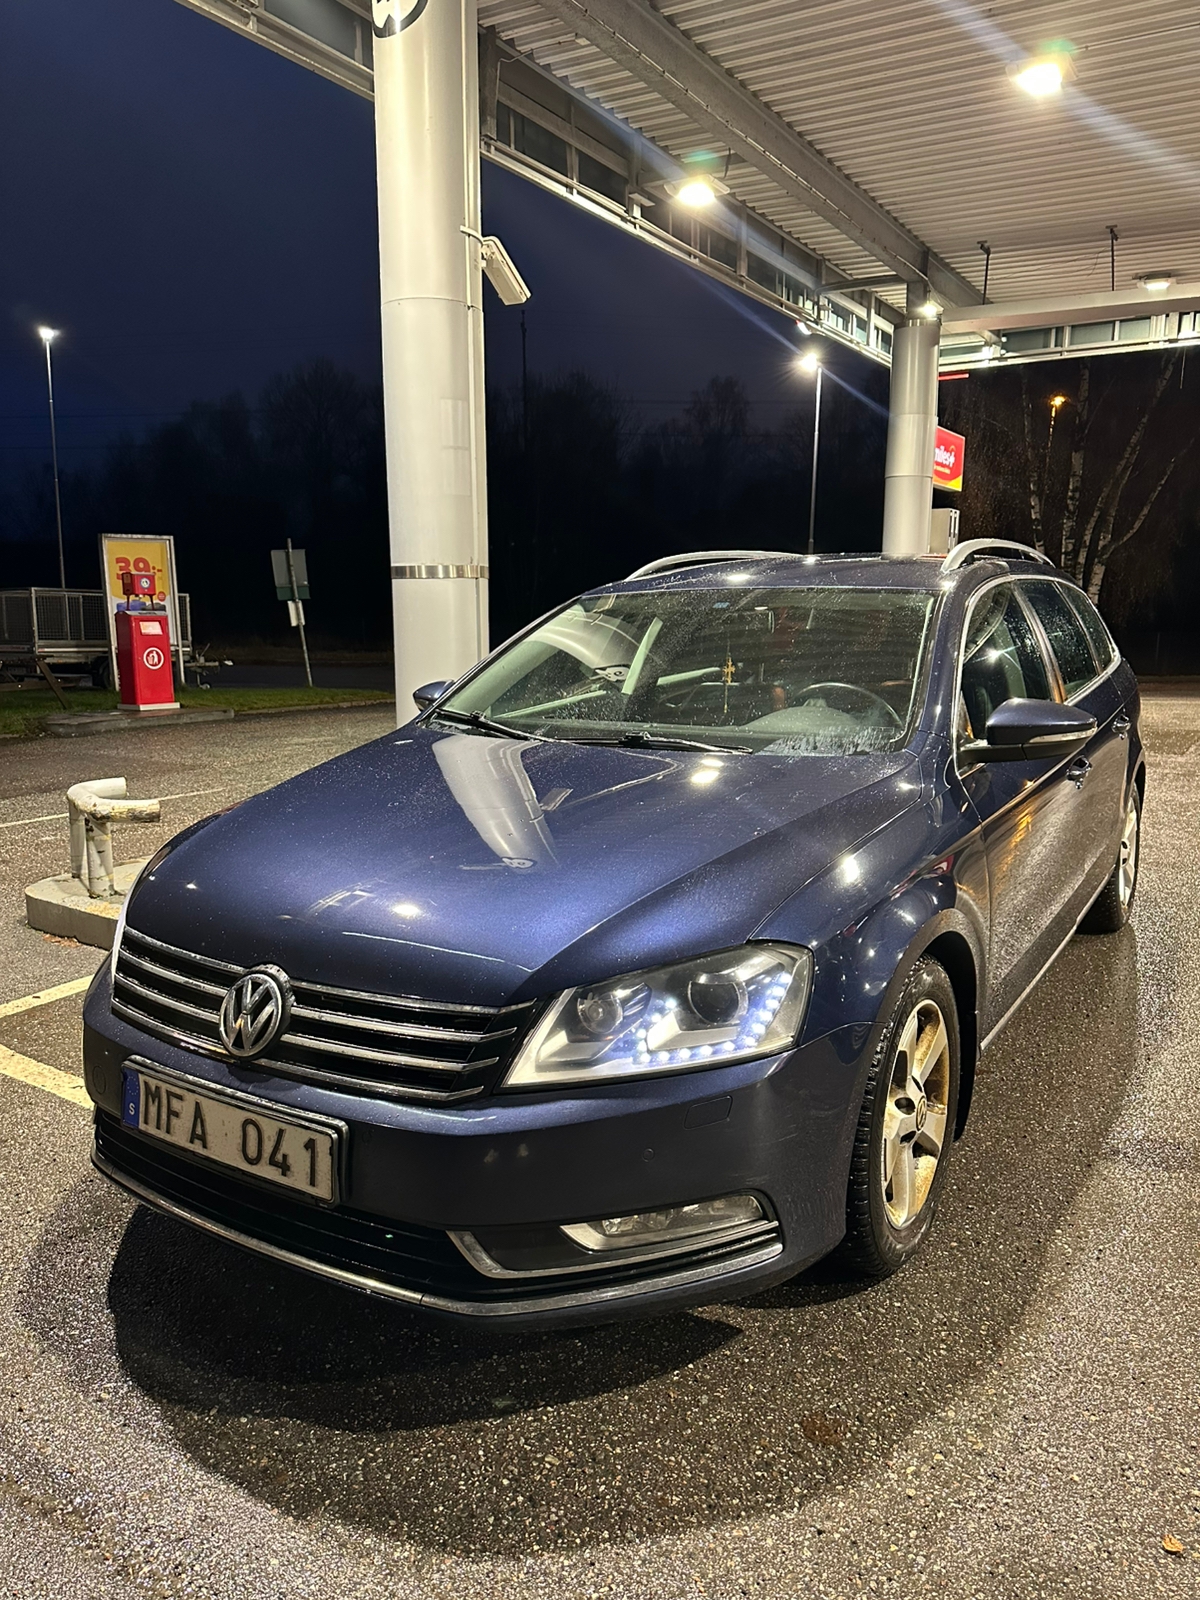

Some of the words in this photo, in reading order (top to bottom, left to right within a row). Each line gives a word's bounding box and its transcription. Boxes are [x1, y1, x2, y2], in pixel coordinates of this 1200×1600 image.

[128, 1102, 136, 1116] S
[141, 1081, 208, 1150] MFA
[241, 1118, 316, 1187] 041
